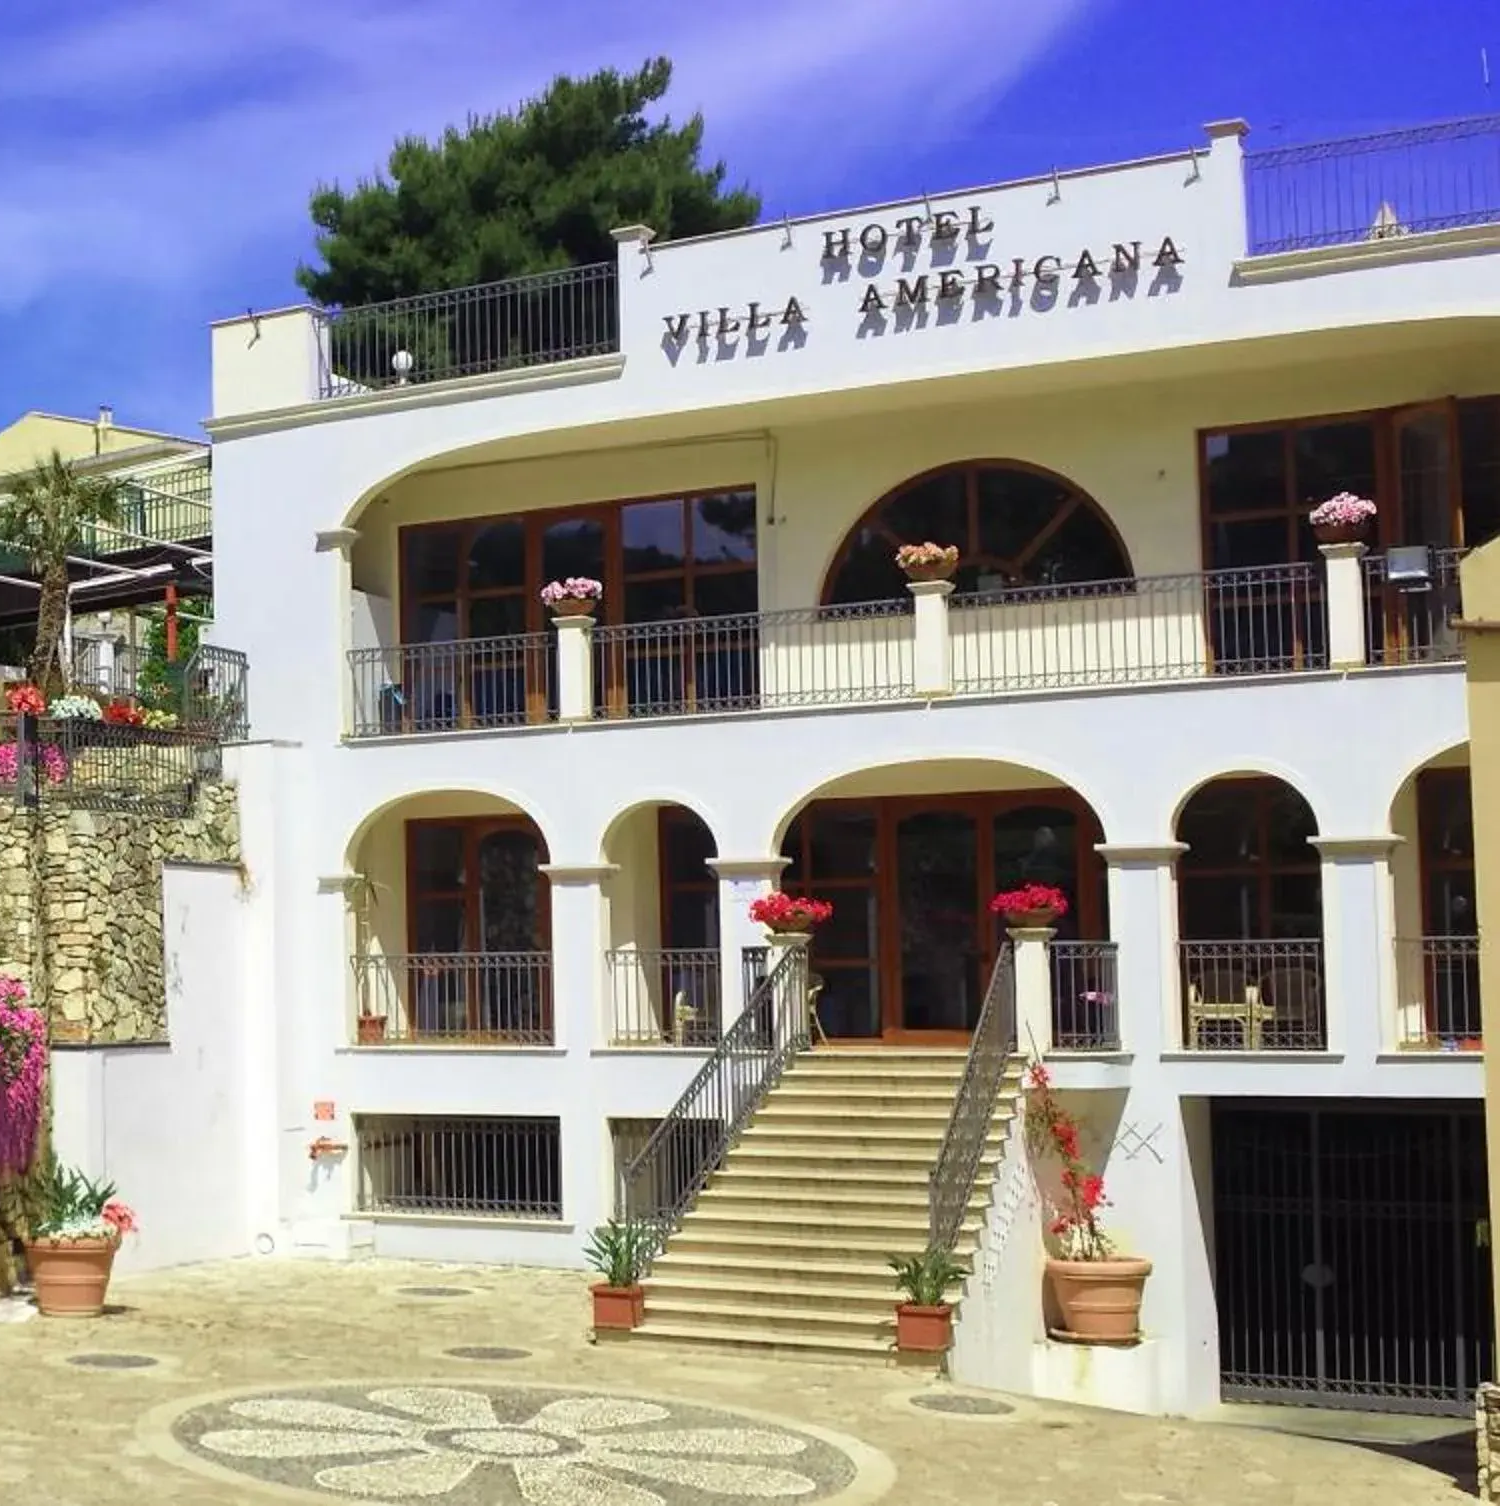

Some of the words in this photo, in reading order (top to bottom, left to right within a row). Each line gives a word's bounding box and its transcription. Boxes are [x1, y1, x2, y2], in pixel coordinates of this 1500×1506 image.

[821, 205, 995, 260] HOTEL
[662, 295, 810, 340] VILLA
[858, 236, 1185, 313] AMERICANA
